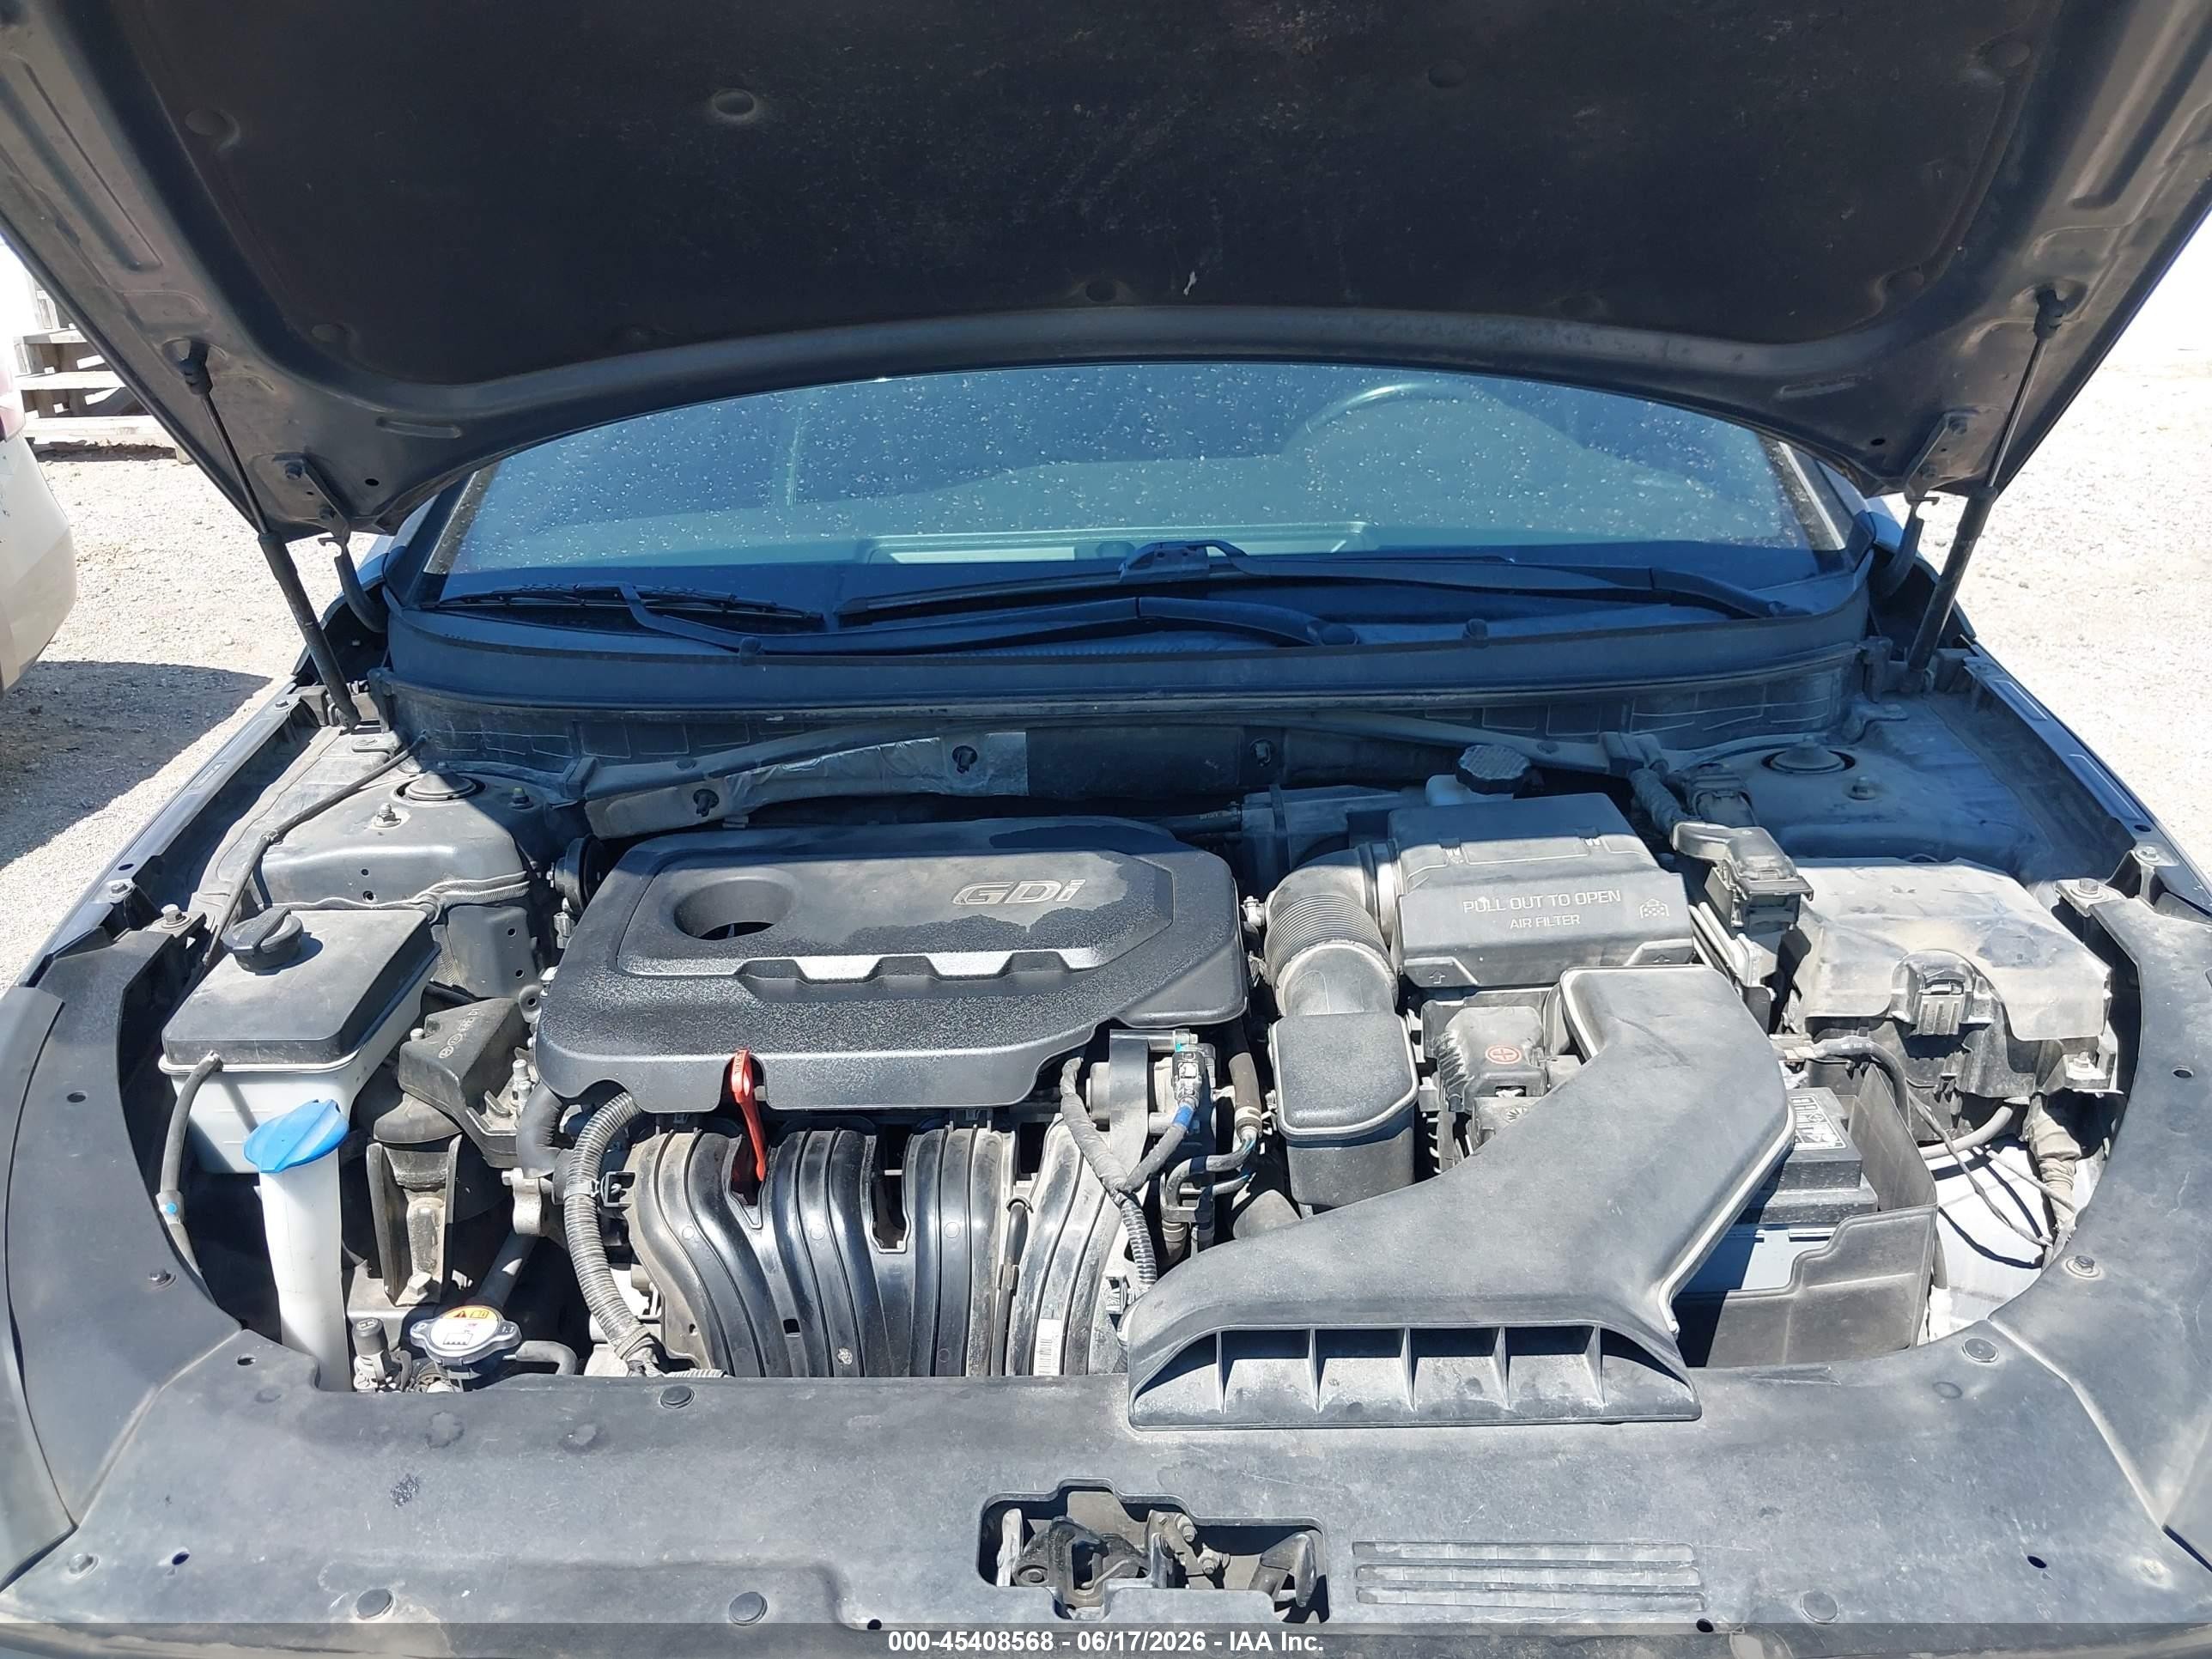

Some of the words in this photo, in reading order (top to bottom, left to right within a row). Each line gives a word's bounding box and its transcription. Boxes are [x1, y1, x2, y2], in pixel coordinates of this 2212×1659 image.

[952, 878, 1086, 905] GDi
[1462, 899, 1506, 914] PULL
[1510, 895, 1544, 910] OUT
[1547, 893, 1571, 907] TO
[1575, 890, 1621, 906] OPEN
[1510, 917, 1533, 929] AIR
[1535, 914, 1581, 928] FILTER
